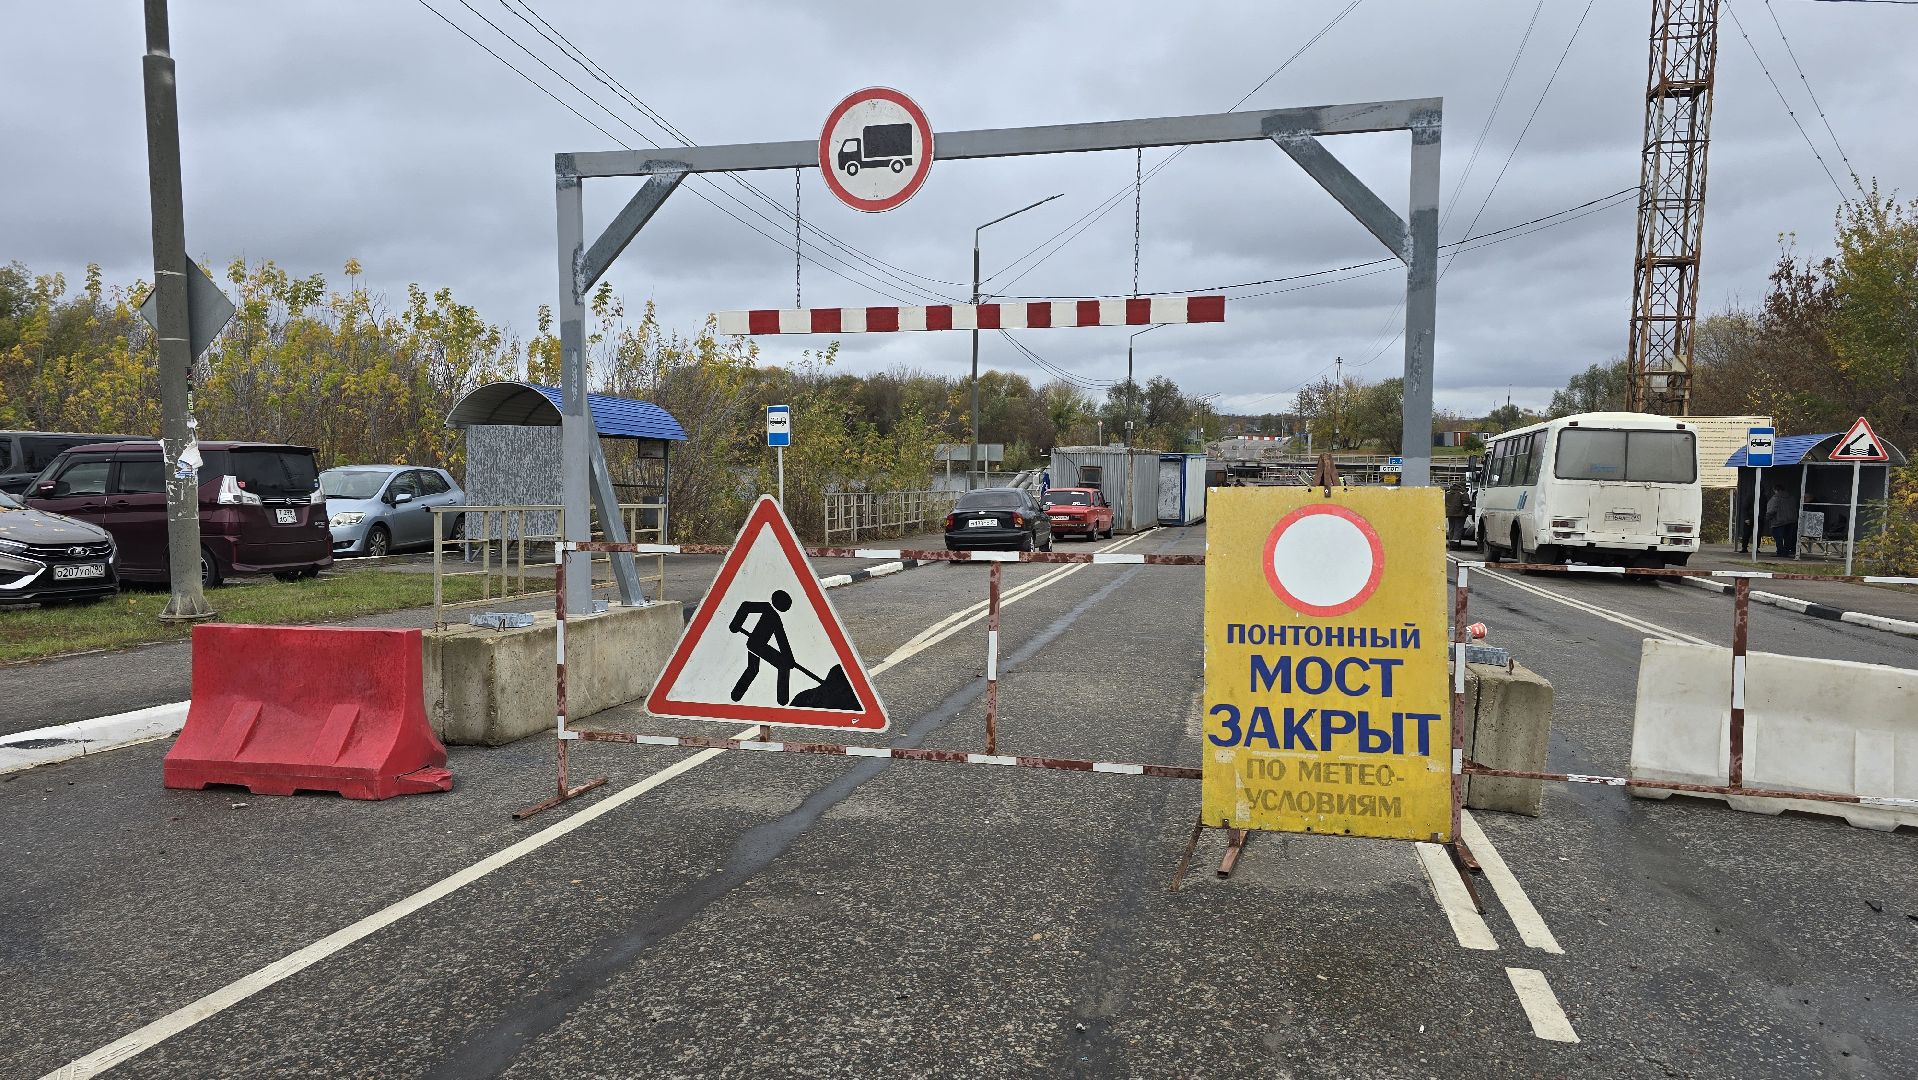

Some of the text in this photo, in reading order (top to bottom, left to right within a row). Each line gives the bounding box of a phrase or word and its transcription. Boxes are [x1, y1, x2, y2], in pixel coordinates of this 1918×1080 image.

[1227, 623, 1421, 649] ПОНТОННЫЙ
[1250, 654, 1404, 698] МОСТ
[1207, 703, 1441, 756] ЗАКРЫТ
[1246, 758, 1405, 787] ПО МЕТЕО-
[1244, 787, 1402, 818] УСЛОВИЯМ
